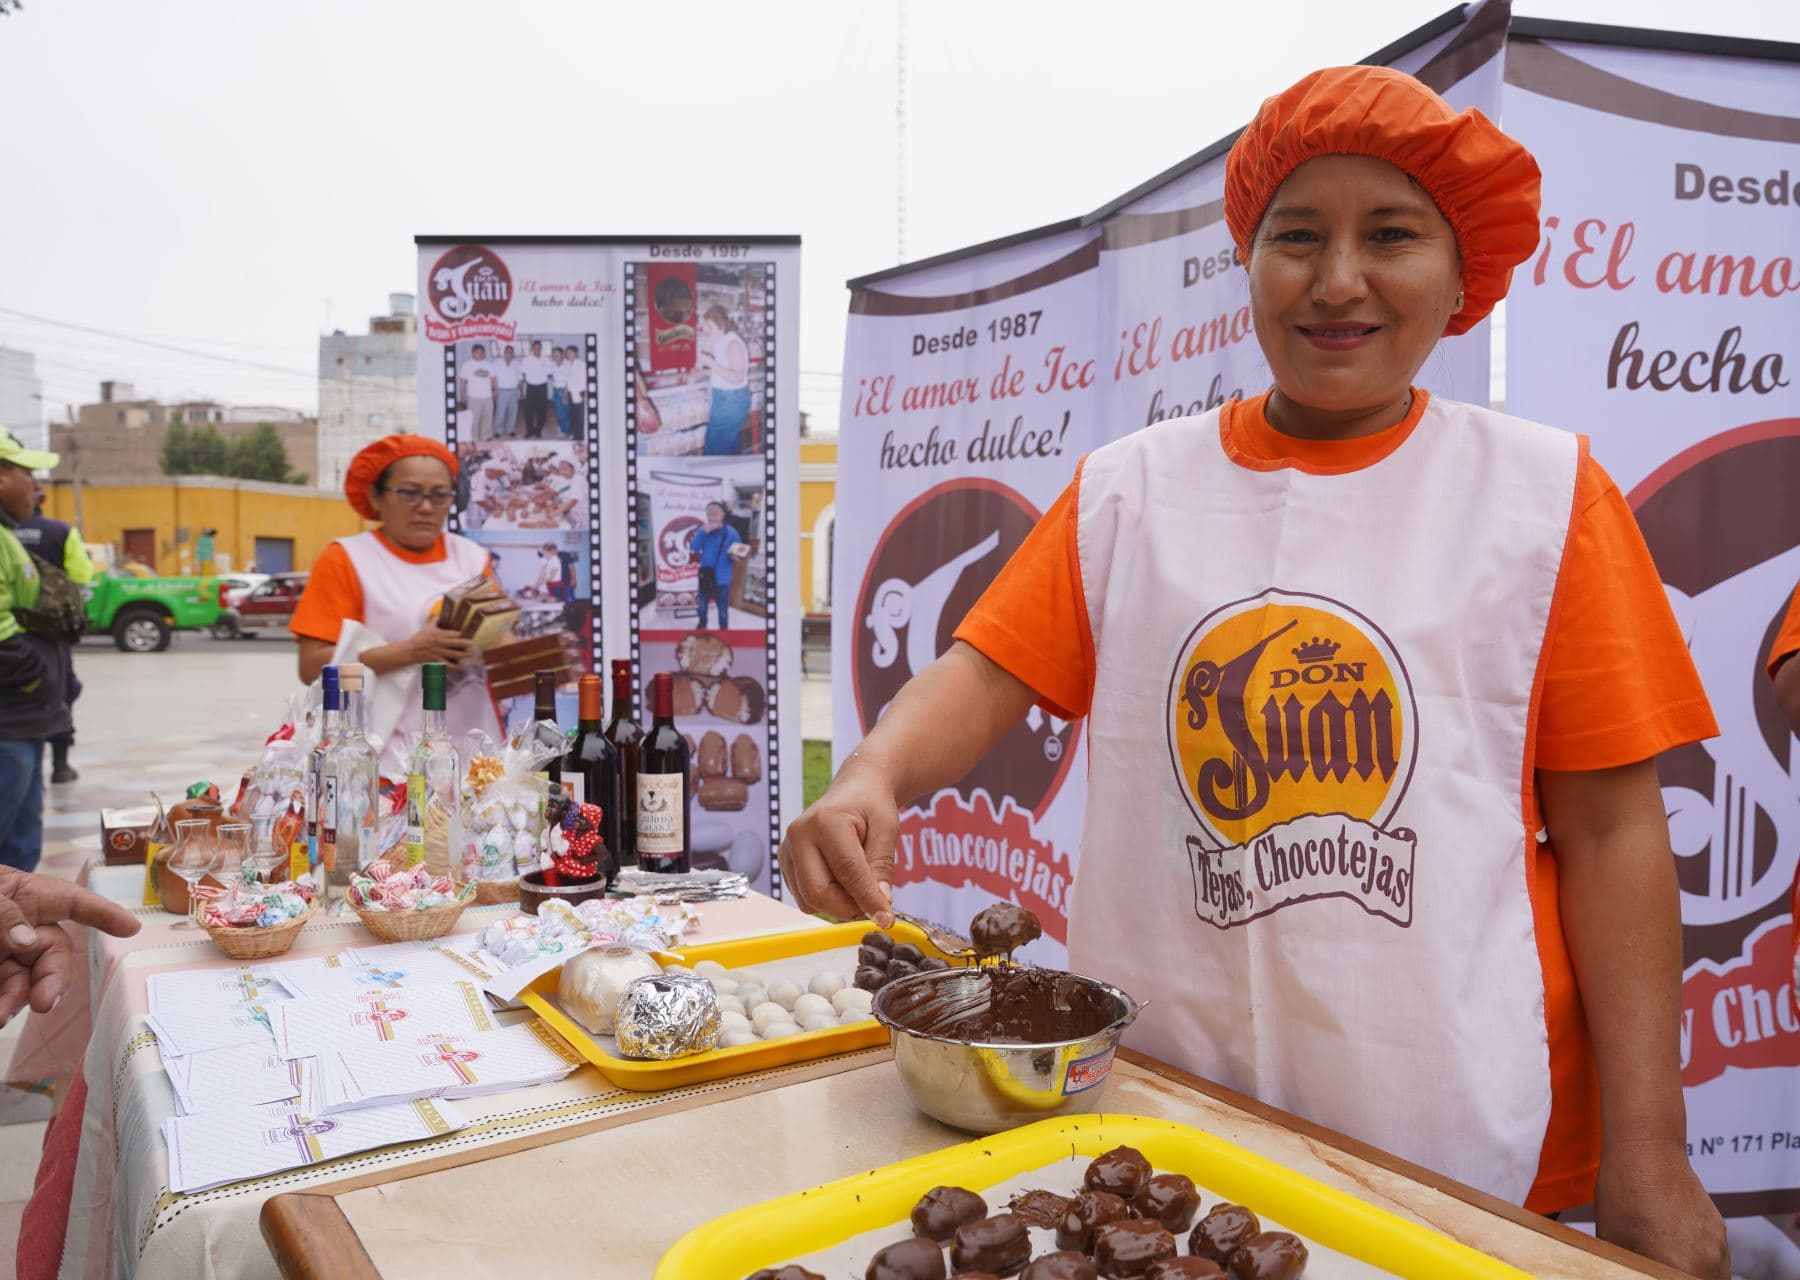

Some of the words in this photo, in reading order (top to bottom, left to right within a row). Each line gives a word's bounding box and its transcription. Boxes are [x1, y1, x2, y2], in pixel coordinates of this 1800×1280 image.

[650, 244, 702, 257] Desde
[711, 244, 751, 257] 1987
[1533, 216, 1636, 291] ¡El
[1656, 252, 1800, 298] amo
[912, 326, 977, 356] Desde
[988, 310, 1042, 343] 1987
[1114, 315, 1162, 382] ¡El
[1171, 305, 1253, 363] amo
[1607, 320, 1790, 394] hecho
[854, 374, 895, 417] ¡El
[901, 376, 980, 411] amor
[990, 354, 1024, 400] de
[880, 425, 957, 470] hecho
[967, 410, 1071, 464] dulce!
[1269, 662, 1367, 689] DON
[1181, 618, 1399, 821] Juan
[901, 833, 914, 871] y
[1198, 851, 1254, 920] Tejas,
[1254, 825, 1410, 908] Chocotejas
[1731, 1134, 1763, 1153] 171
